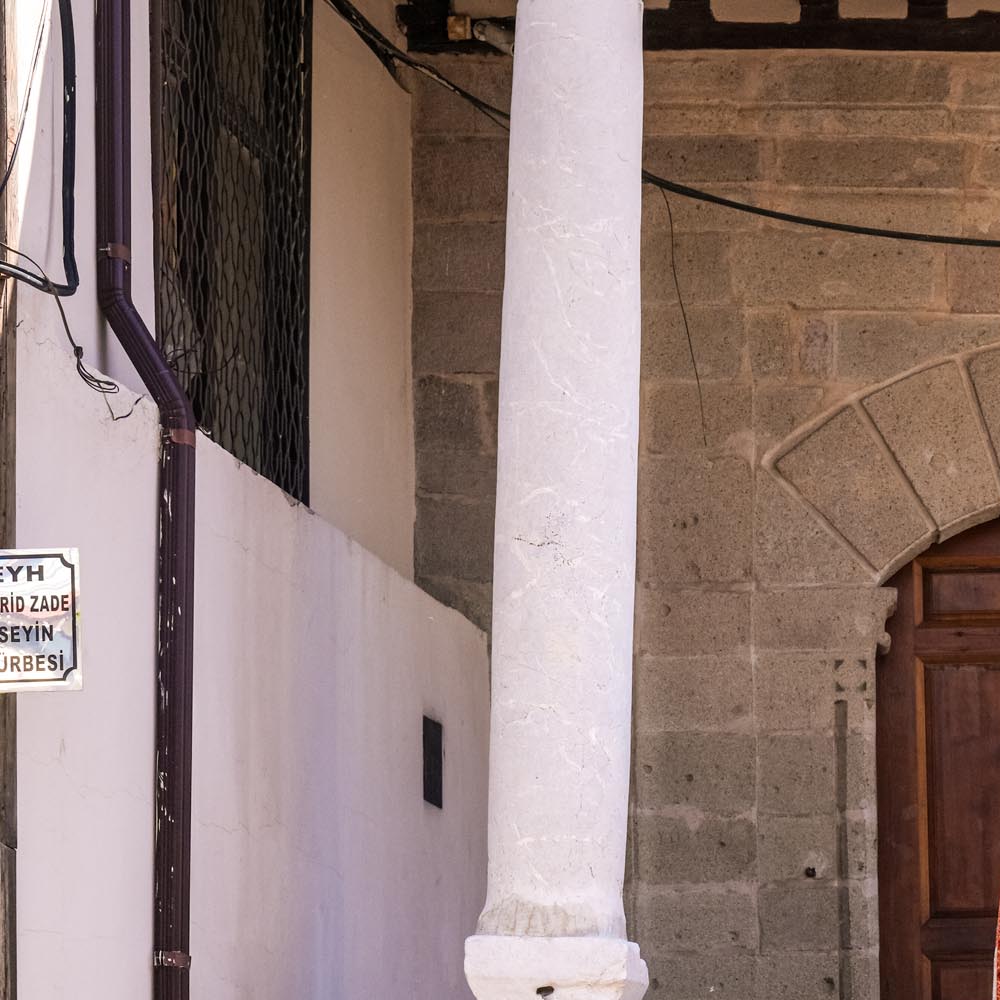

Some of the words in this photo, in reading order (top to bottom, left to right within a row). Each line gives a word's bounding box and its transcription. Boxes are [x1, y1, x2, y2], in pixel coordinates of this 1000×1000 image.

[0, 592, 25, 613] RİD
[30, 594, 70, 613] ZADE
[0, 621, 54, 643] SEYİN
[0, 650, 64, 672] ÜRBESİ
